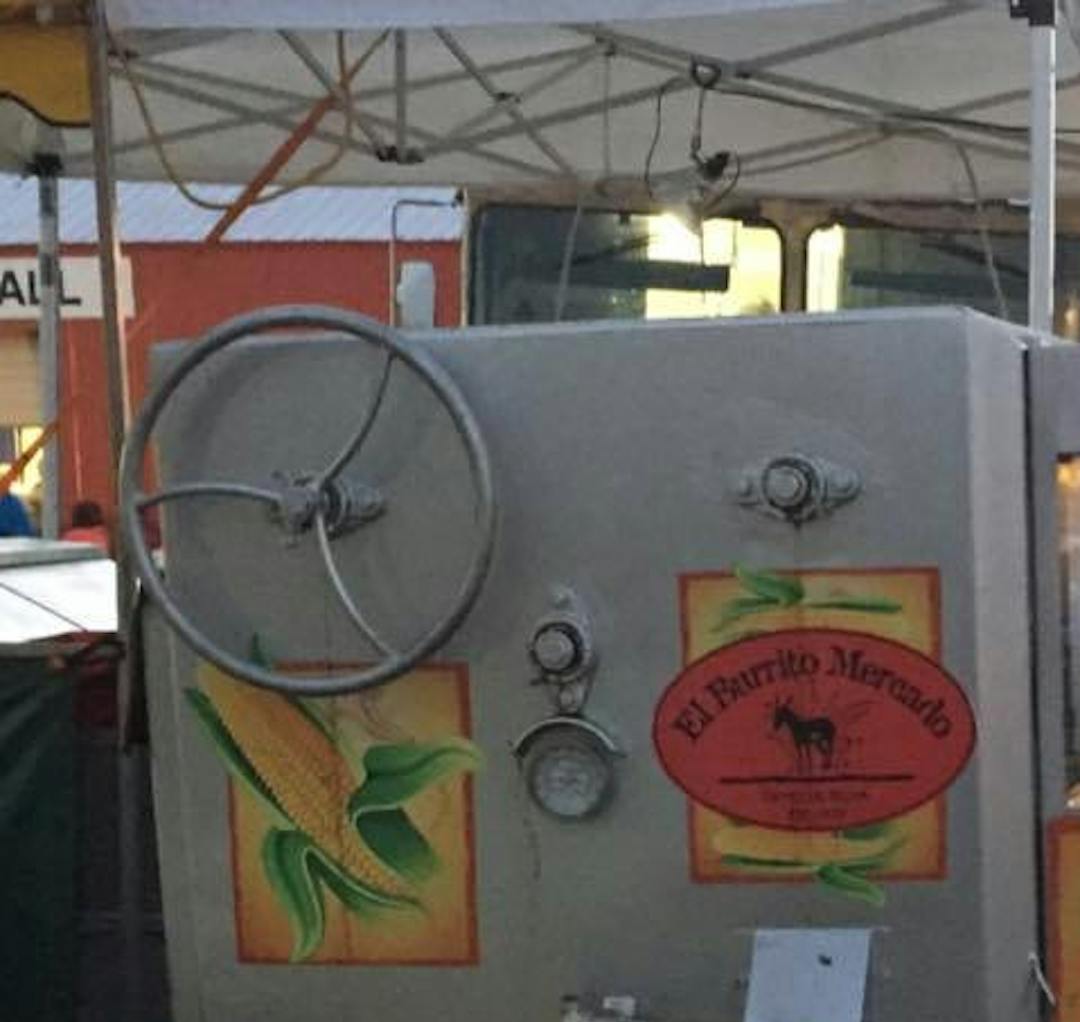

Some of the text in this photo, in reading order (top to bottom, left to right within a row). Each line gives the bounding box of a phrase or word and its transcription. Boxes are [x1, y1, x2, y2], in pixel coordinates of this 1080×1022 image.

[0, 271, 82, 305] ALL
[672, 646, 953, 743] El Burrito Mercado
